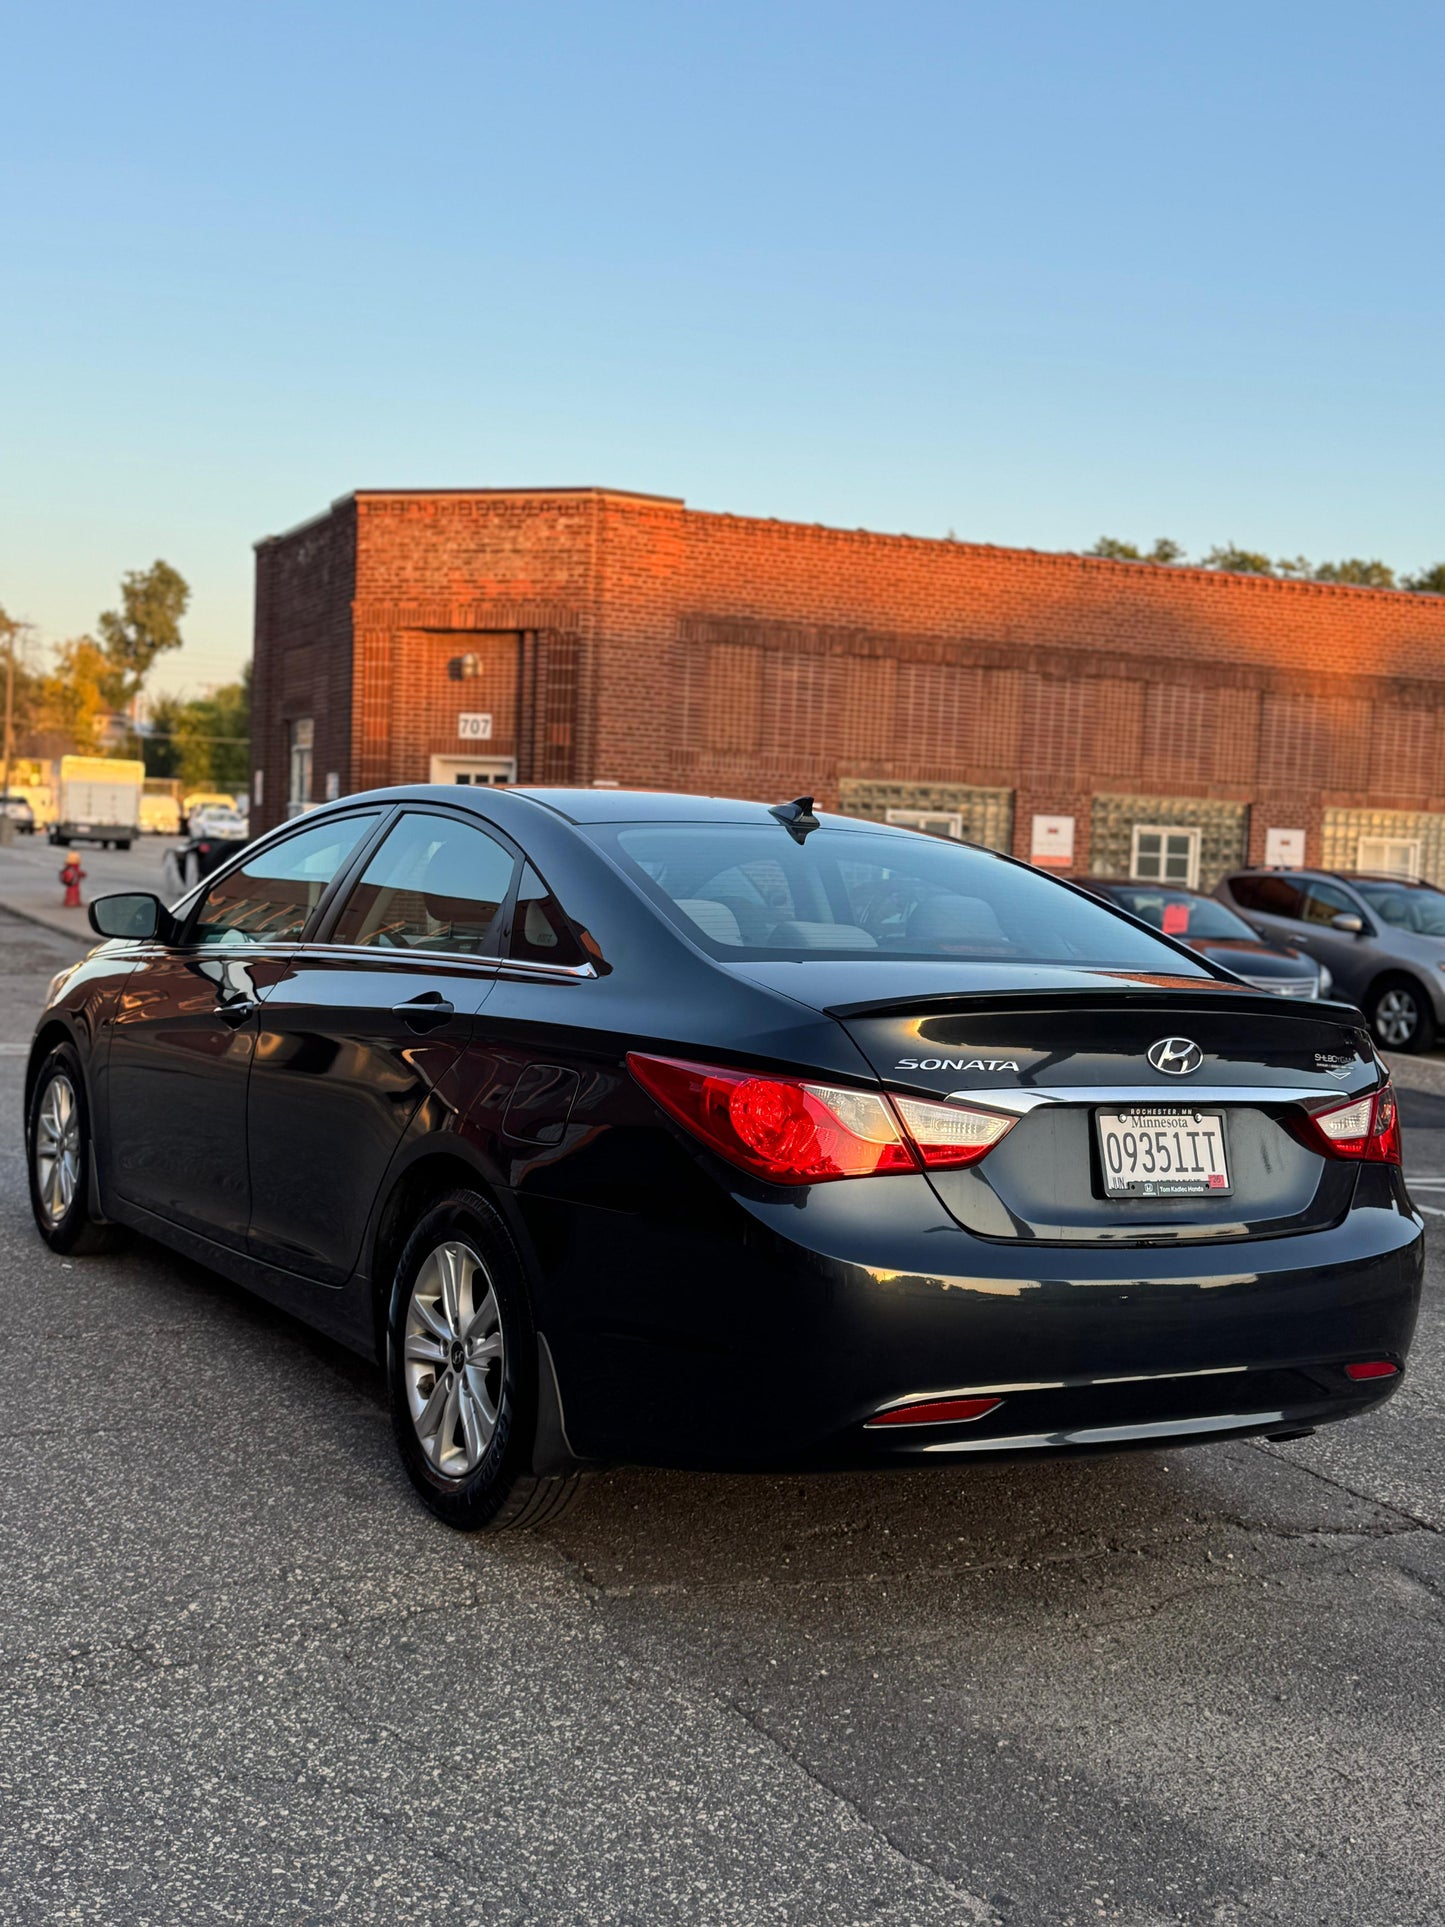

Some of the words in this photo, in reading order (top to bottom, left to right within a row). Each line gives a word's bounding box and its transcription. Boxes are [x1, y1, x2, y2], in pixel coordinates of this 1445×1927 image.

[460, 718, 489, 735] 707
[894, 1058, 1020, 1072] SONATA
[1131, 1115, 1188, 1128] Minnesota
[1106, 1131, 1216, 1174] 09351IT
